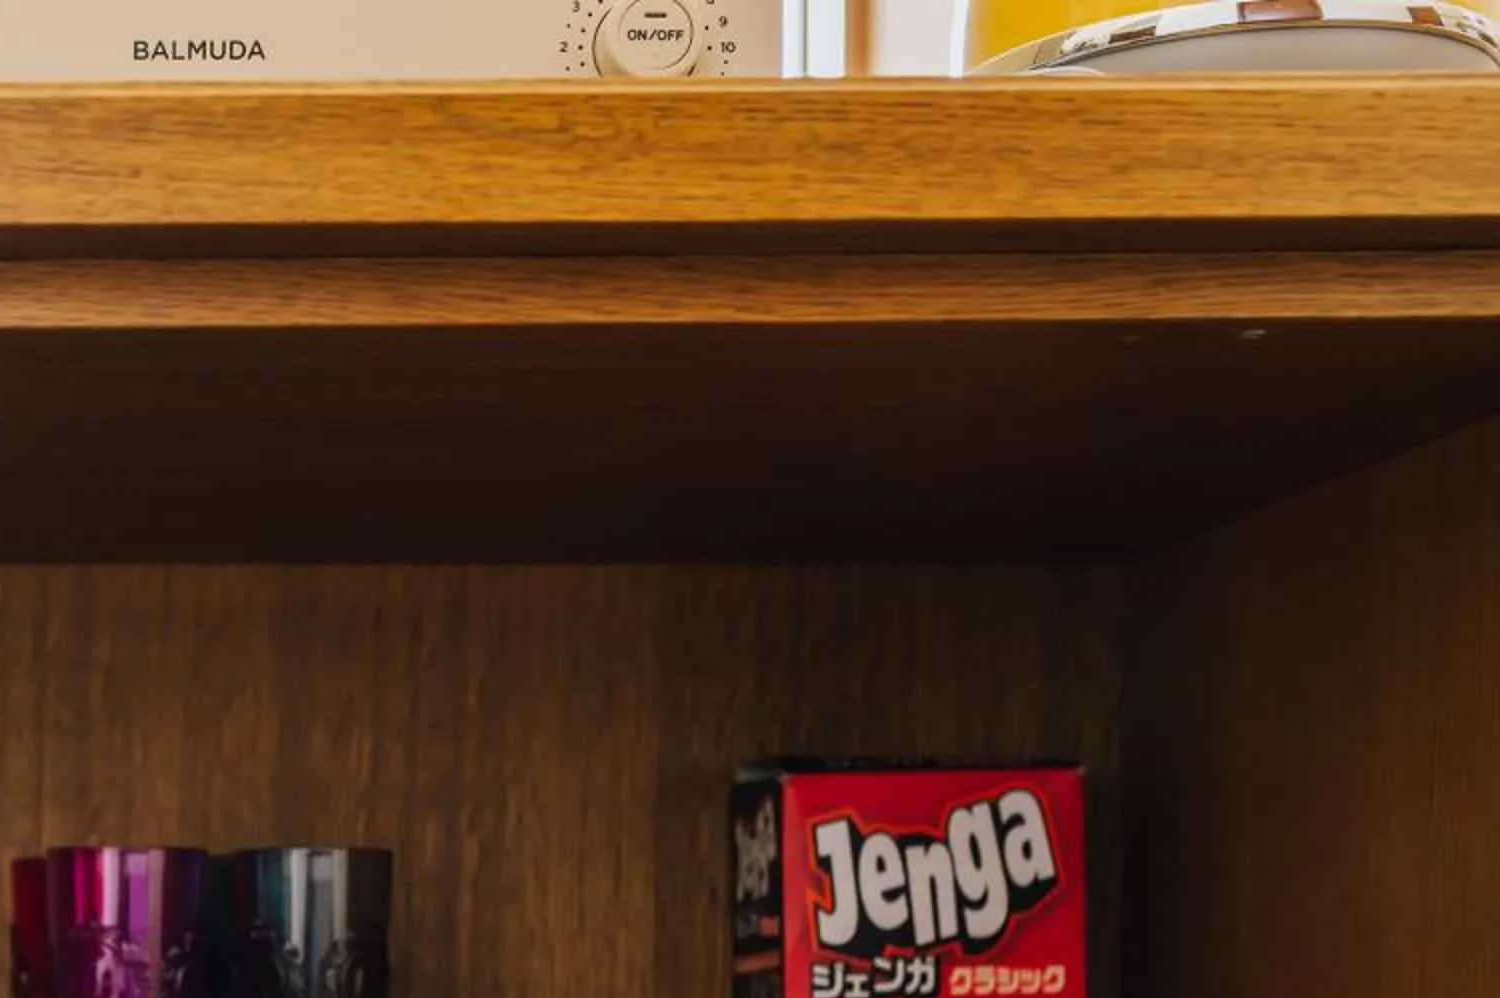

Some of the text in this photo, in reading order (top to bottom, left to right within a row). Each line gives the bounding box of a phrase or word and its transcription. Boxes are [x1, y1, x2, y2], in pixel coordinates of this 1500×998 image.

[572, 1, 581, 12] 3
[719, 16, 728, 27] 9
[627, 29, 685, 42] ON/OFF
[133, 39, 266, 61] BALMUDA
[559, 41, 568, 52] 2
[720, 42, 737, 53] 10
[815, 788, 1057, 948] Jenga
[949, 964, 1067, 996] クラシック
